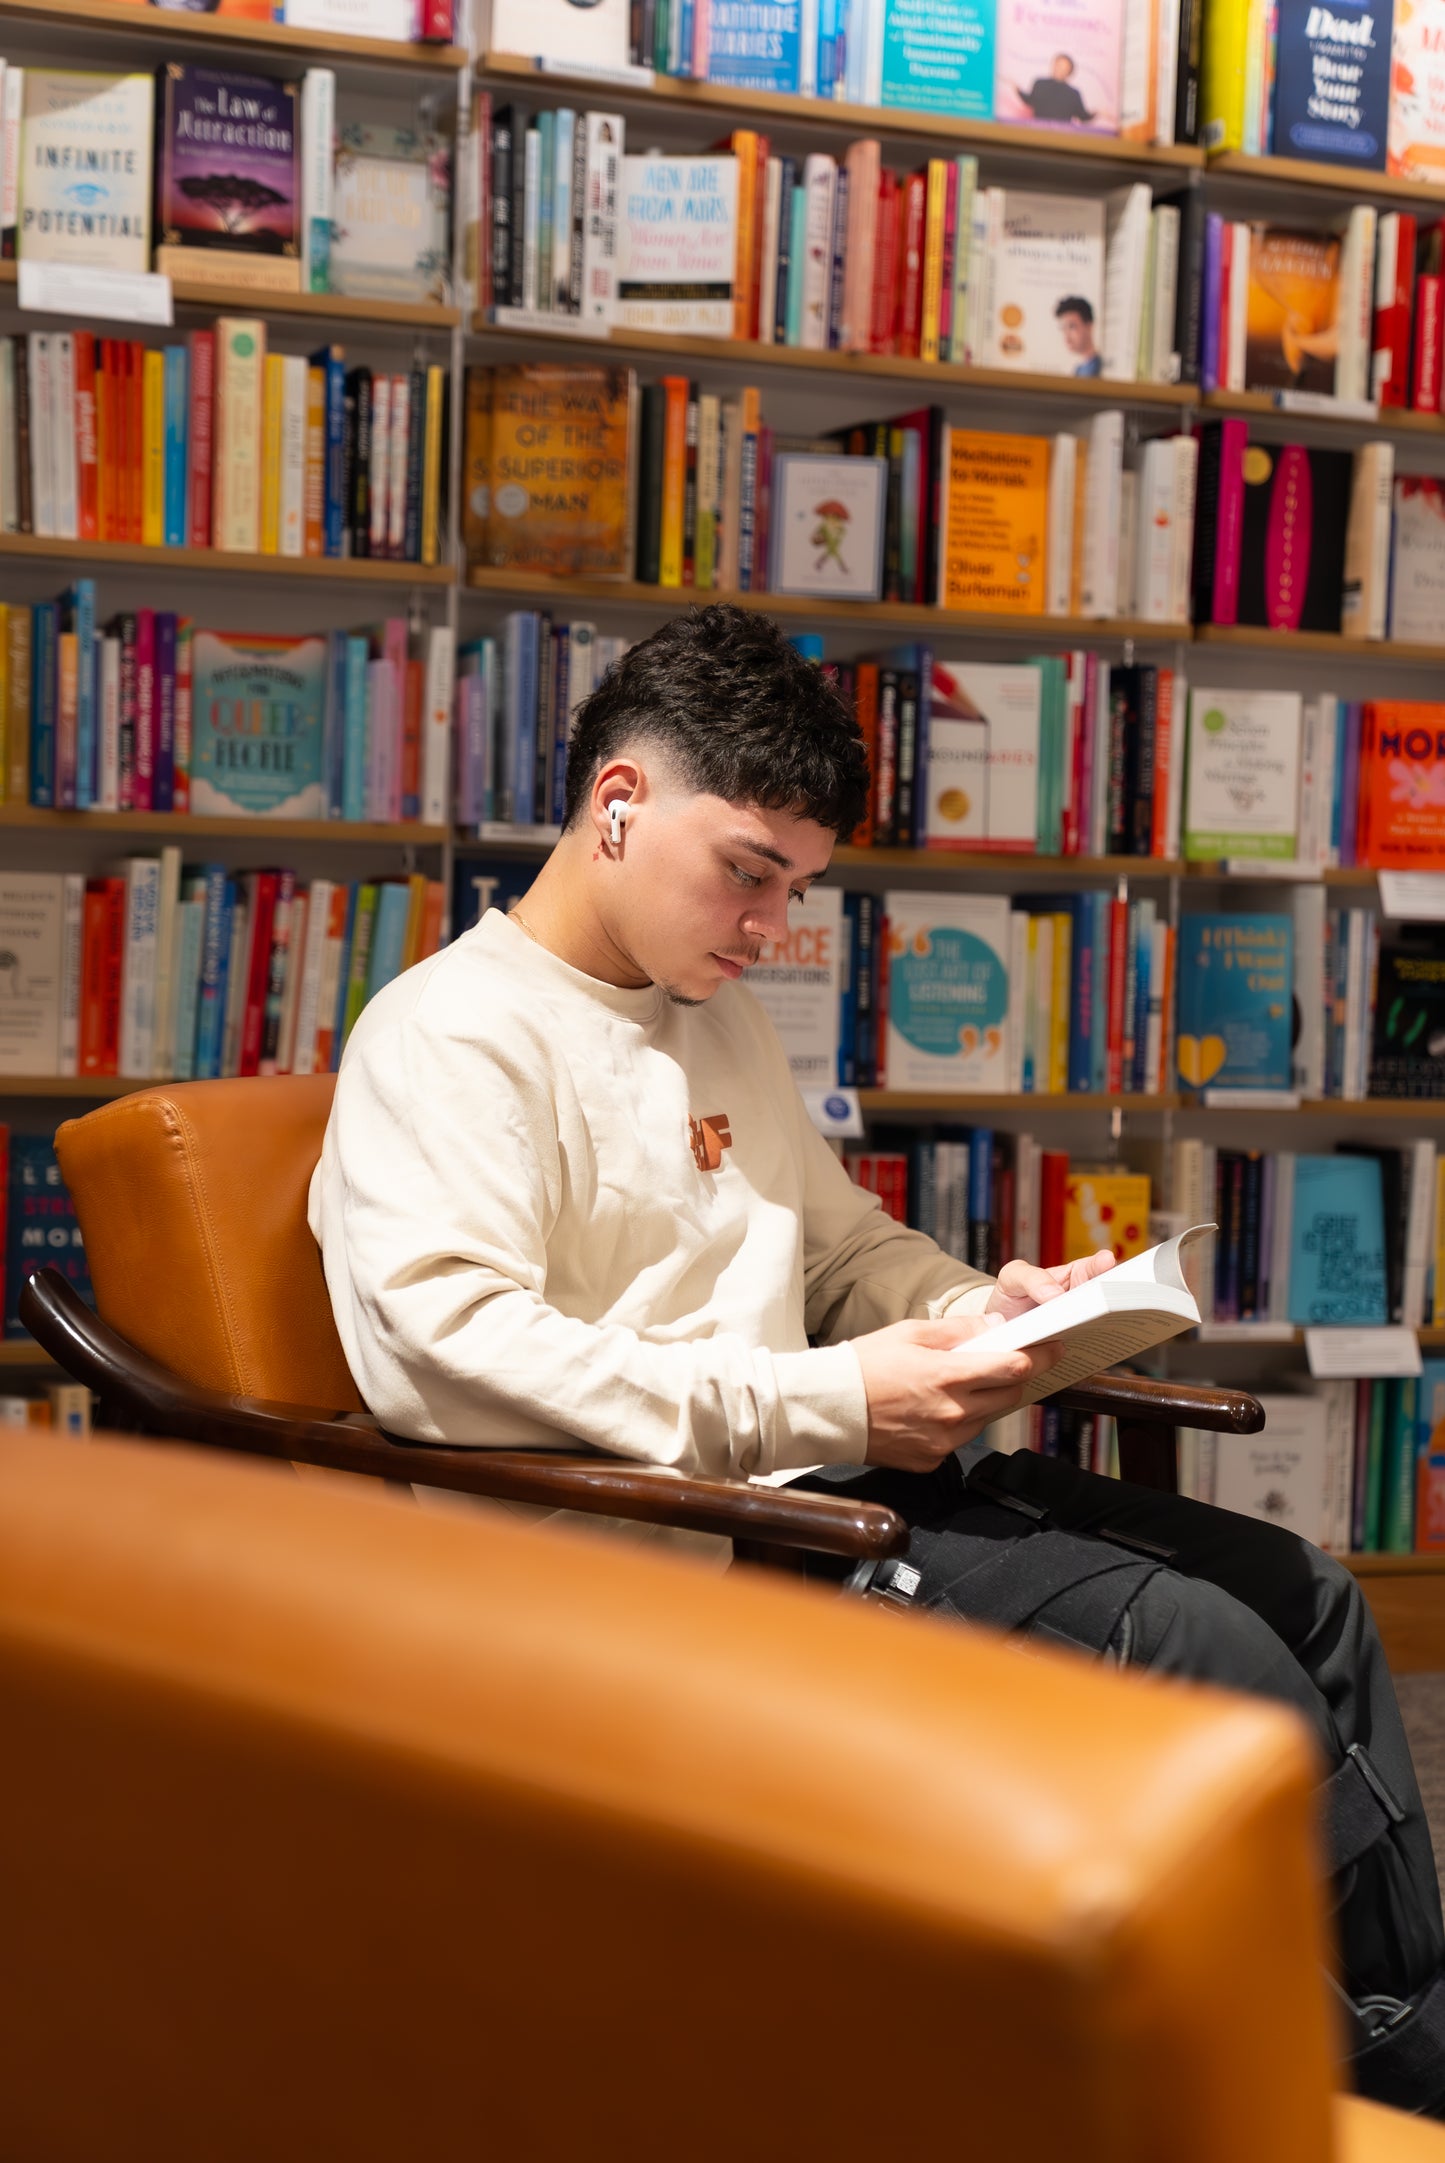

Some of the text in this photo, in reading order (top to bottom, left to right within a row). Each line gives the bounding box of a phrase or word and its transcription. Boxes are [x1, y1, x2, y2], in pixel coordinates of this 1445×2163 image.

[217, 87, 262, 119] Law
[1314, 76, 1361, 104] Your
[1307, 96, 1364, 129] Story
[177, 109, 292, 152] Attraction
[36, 144, 137, 174] INFINITE
[642, 163, 719, 193] MEN ARE
[627, 194, 675, 223] FROM
[24, 207, 143, 239] POTENTIAL
[509, 392, 617, 416] THE WAY
[516, 424, 607, 448] OF THE
[499, 457, 623, 481] SUPERIOR
[952, 449, 1032, 467] Meditations
[973, 470, 1026, 487] Mortals
[529, 493, 590, 513] MAN
[950, 557, 994, 576] Oliver
[949, 580, 1031, 600] Burkeman
[209, 697, 309, 737] QUEER
[216, 738, 294, 772] PEOPLE
[758, 927, 831, 967] ERCE
[936, 939, 960, 960] THE
[909, 983, 987, 1004] LISTENING
